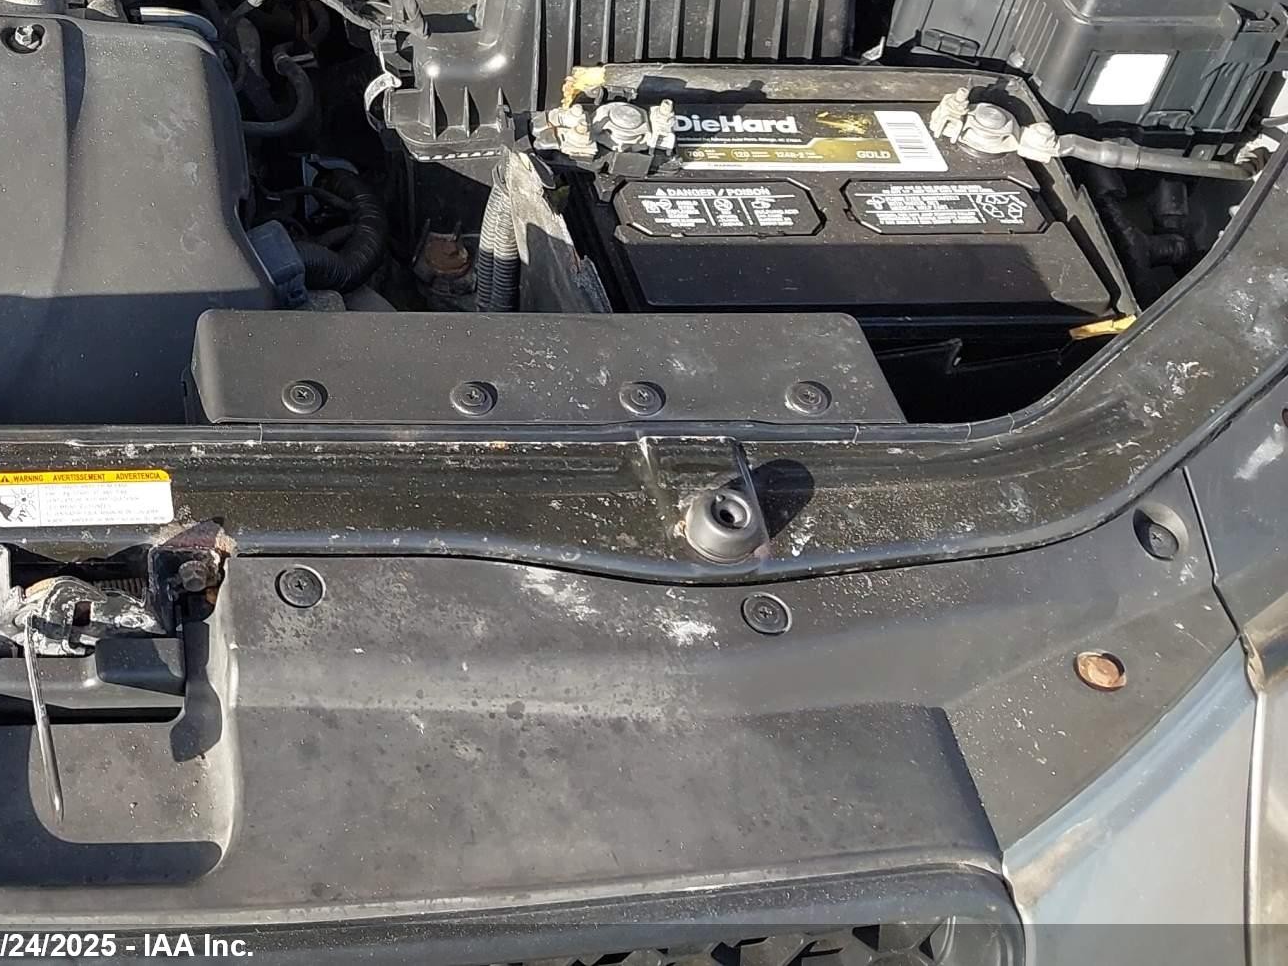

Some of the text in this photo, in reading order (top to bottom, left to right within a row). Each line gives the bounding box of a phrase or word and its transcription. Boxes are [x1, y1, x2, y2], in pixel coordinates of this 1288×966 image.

[674, 114, 799, 134] DieHard
[856, 150, 891, 159] GOLD
[667, 188, 717, 197] DANGER
[727, 186, 771, 196] POISON
[13, 472, 161, 482] WARNING AVERTISSEMENT ADVERTENCIA
